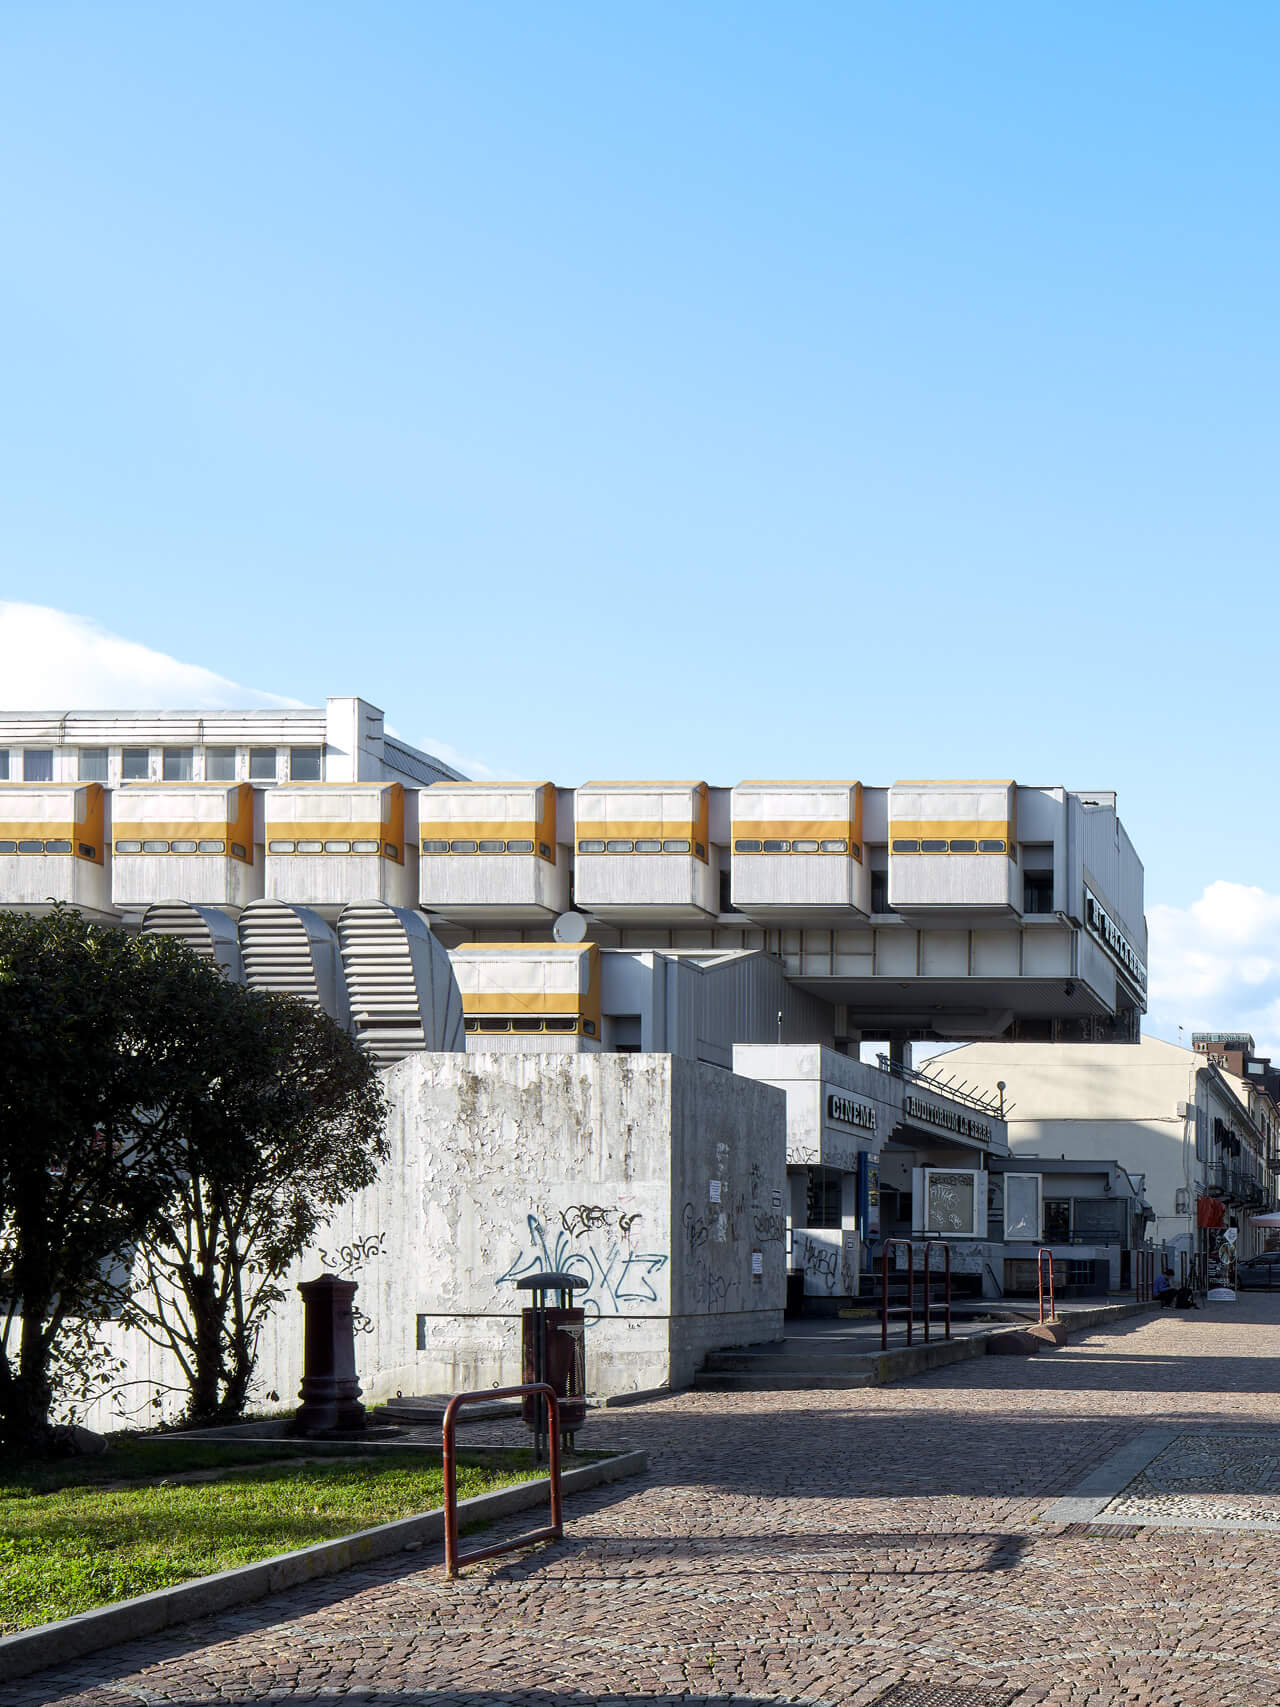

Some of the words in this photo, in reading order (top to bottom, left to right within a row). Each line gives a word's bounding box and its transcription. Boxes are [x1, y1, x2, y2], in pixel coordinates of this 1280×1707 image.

[831, 1094, 877, 1130] CINEMA
[910, 1097, 959, 1132] AUDITORIUM
[960, 1116, 969, 1135] LA
[970, 1120, 991, 1142] SERRA
